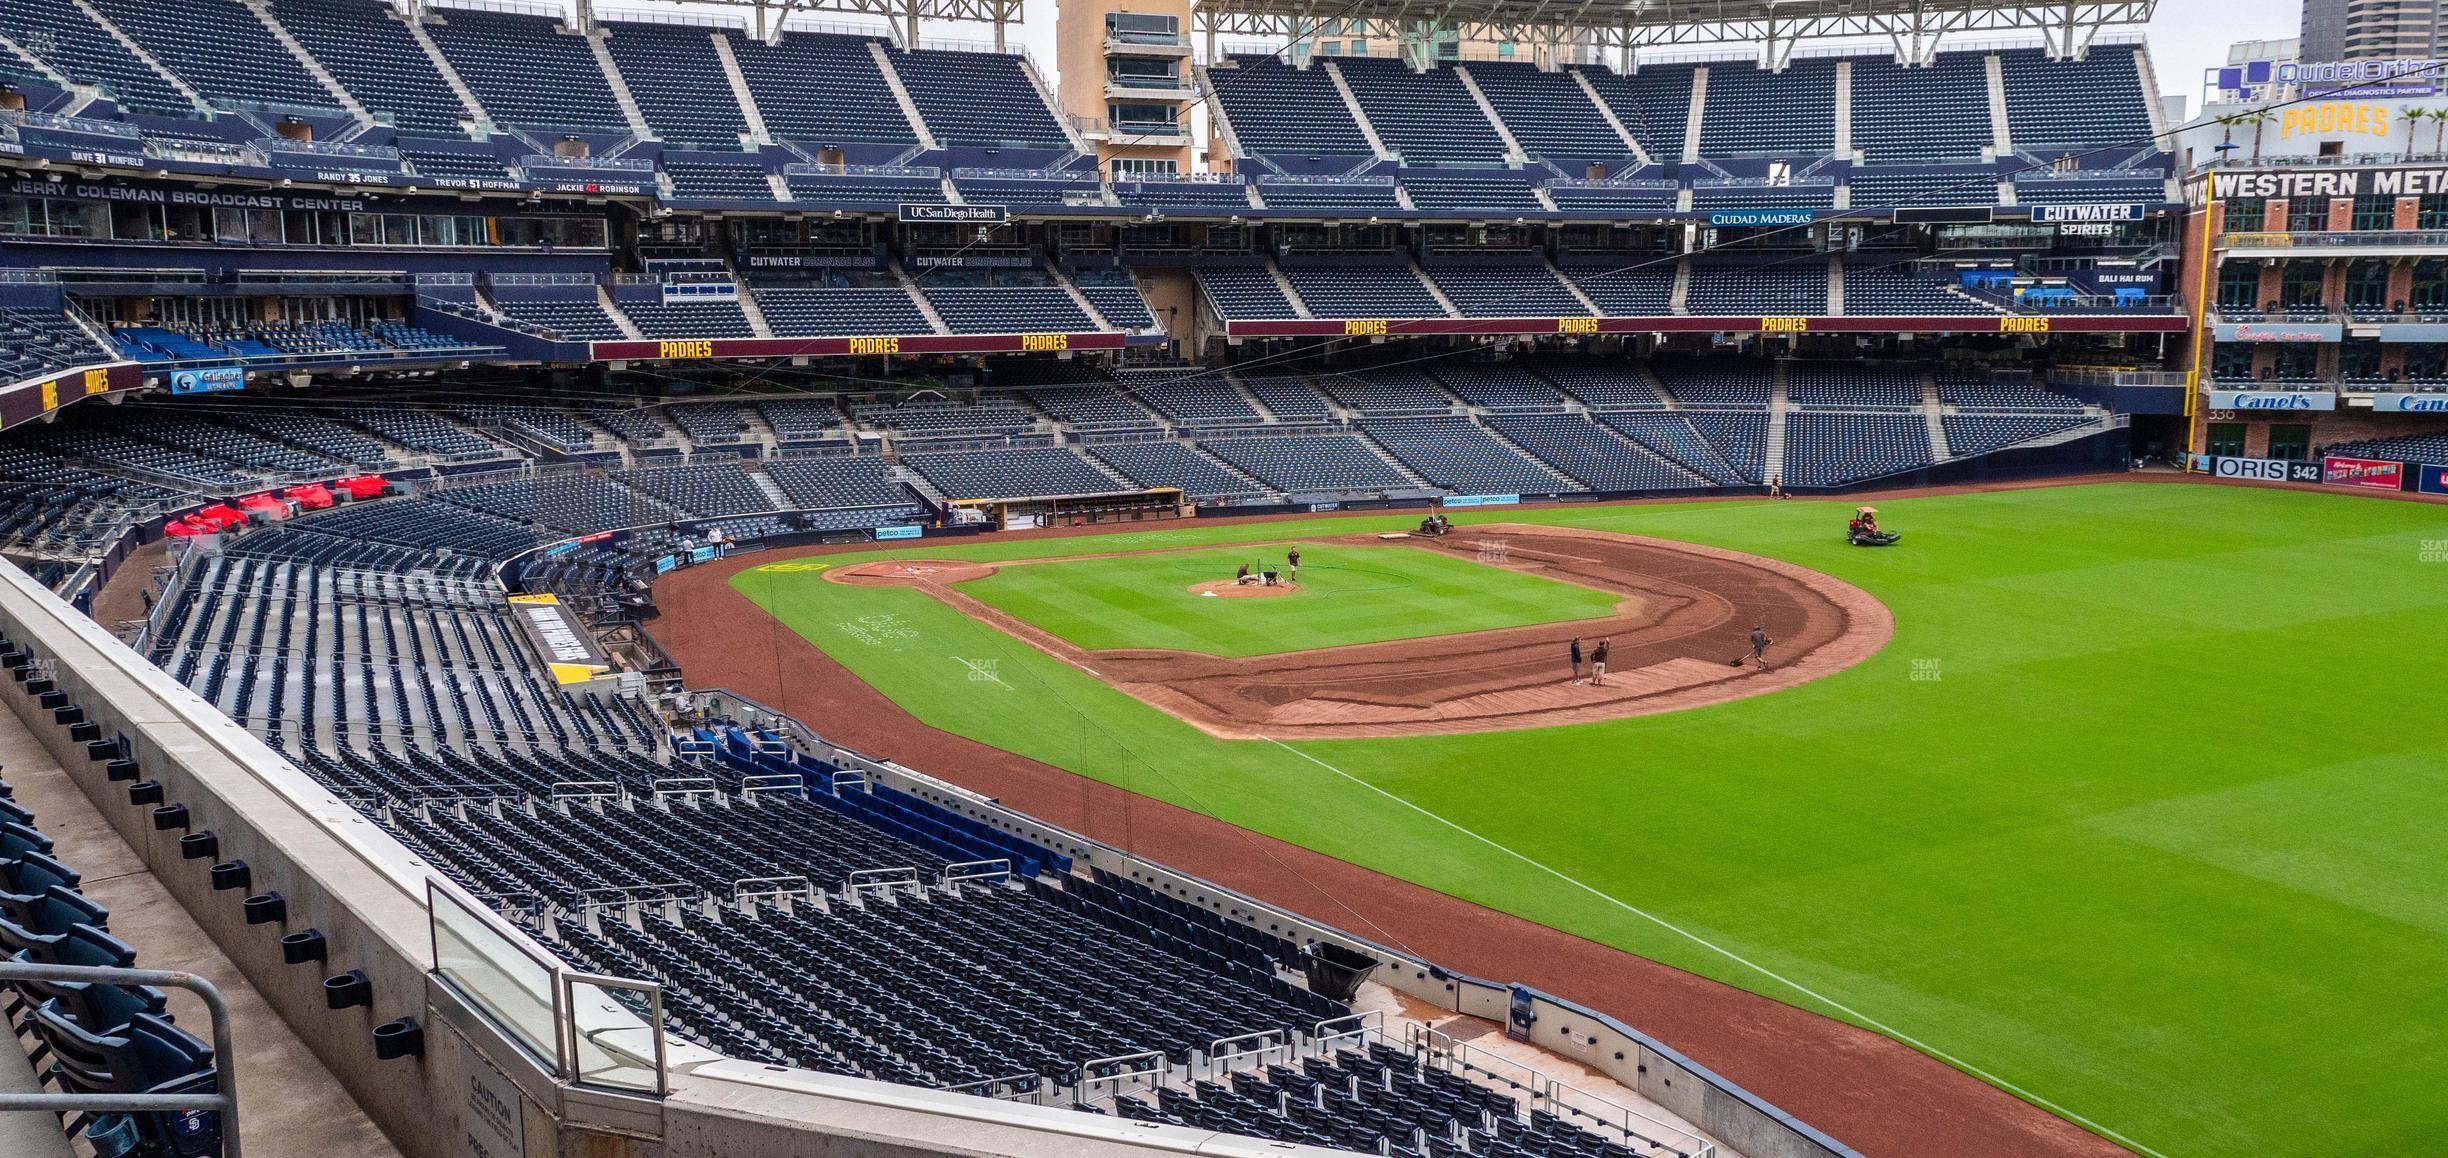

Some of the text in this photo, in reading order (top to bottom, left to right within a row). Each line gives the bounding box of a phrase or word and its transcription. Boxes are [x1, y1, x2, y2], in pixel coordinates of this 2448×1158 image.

[2278, 60, 2439, 86] QuidelOrtho
[2342, 88, 2395, 97] DIAGNOSTICS
[2396, 87, 2431, 95] PARTNER
[2283, 103, 2388, 140] PADRES
[72, 151, 144, 167] DAVE 31 WINFIELD
[318, 172, 388, 184] RANDY 35 JONES
[434, 178, 520, 190] TREVOR 51 HOFFMAN
[2213, 172, 2359, 197] WESTERN
[556, 183, 640, 193] JACKIE 42 ROBINSON
[11, 181, 364, 211] JERRY COLEMAN BROADCAST CENTER
[911, 207, 996, 220] UC San Diego Health
[1711, 213, 1811, 225] CIUDAD MADERAS
[2044, 204, 2131, 221] CUTWATER
[2060, 224, 2113, 236] SPIRITS
[751, 257, 800, 266] CUTWATER
[917, 257, 963, 267] CUTWATER
[2098, 275, 2117, 283] BALI
[2135, 275, 2154, 283] RUM
[1345, 320, 1387, 335] PADRES
[1559, 319, 1598, 333] PADRES
[1762, 318, 1807, 331] PADRES
[2000, 318, 2049, 331] PADRES
[850, 337, 899, 354] PADRES
[1022, 334, 1067, 350] PADRES
[660, 341, 712, 358] PADRES
[2233, 393, 2312, 410] Canel's
[2399, 395, 2448, 411] Can
[2220, 459, 2285, 479] ORIS
[2292, 466, 2318, 480] 342
[877, 530, 899, 539] petco
[471, 1075, 511, 1124] CAUTION
